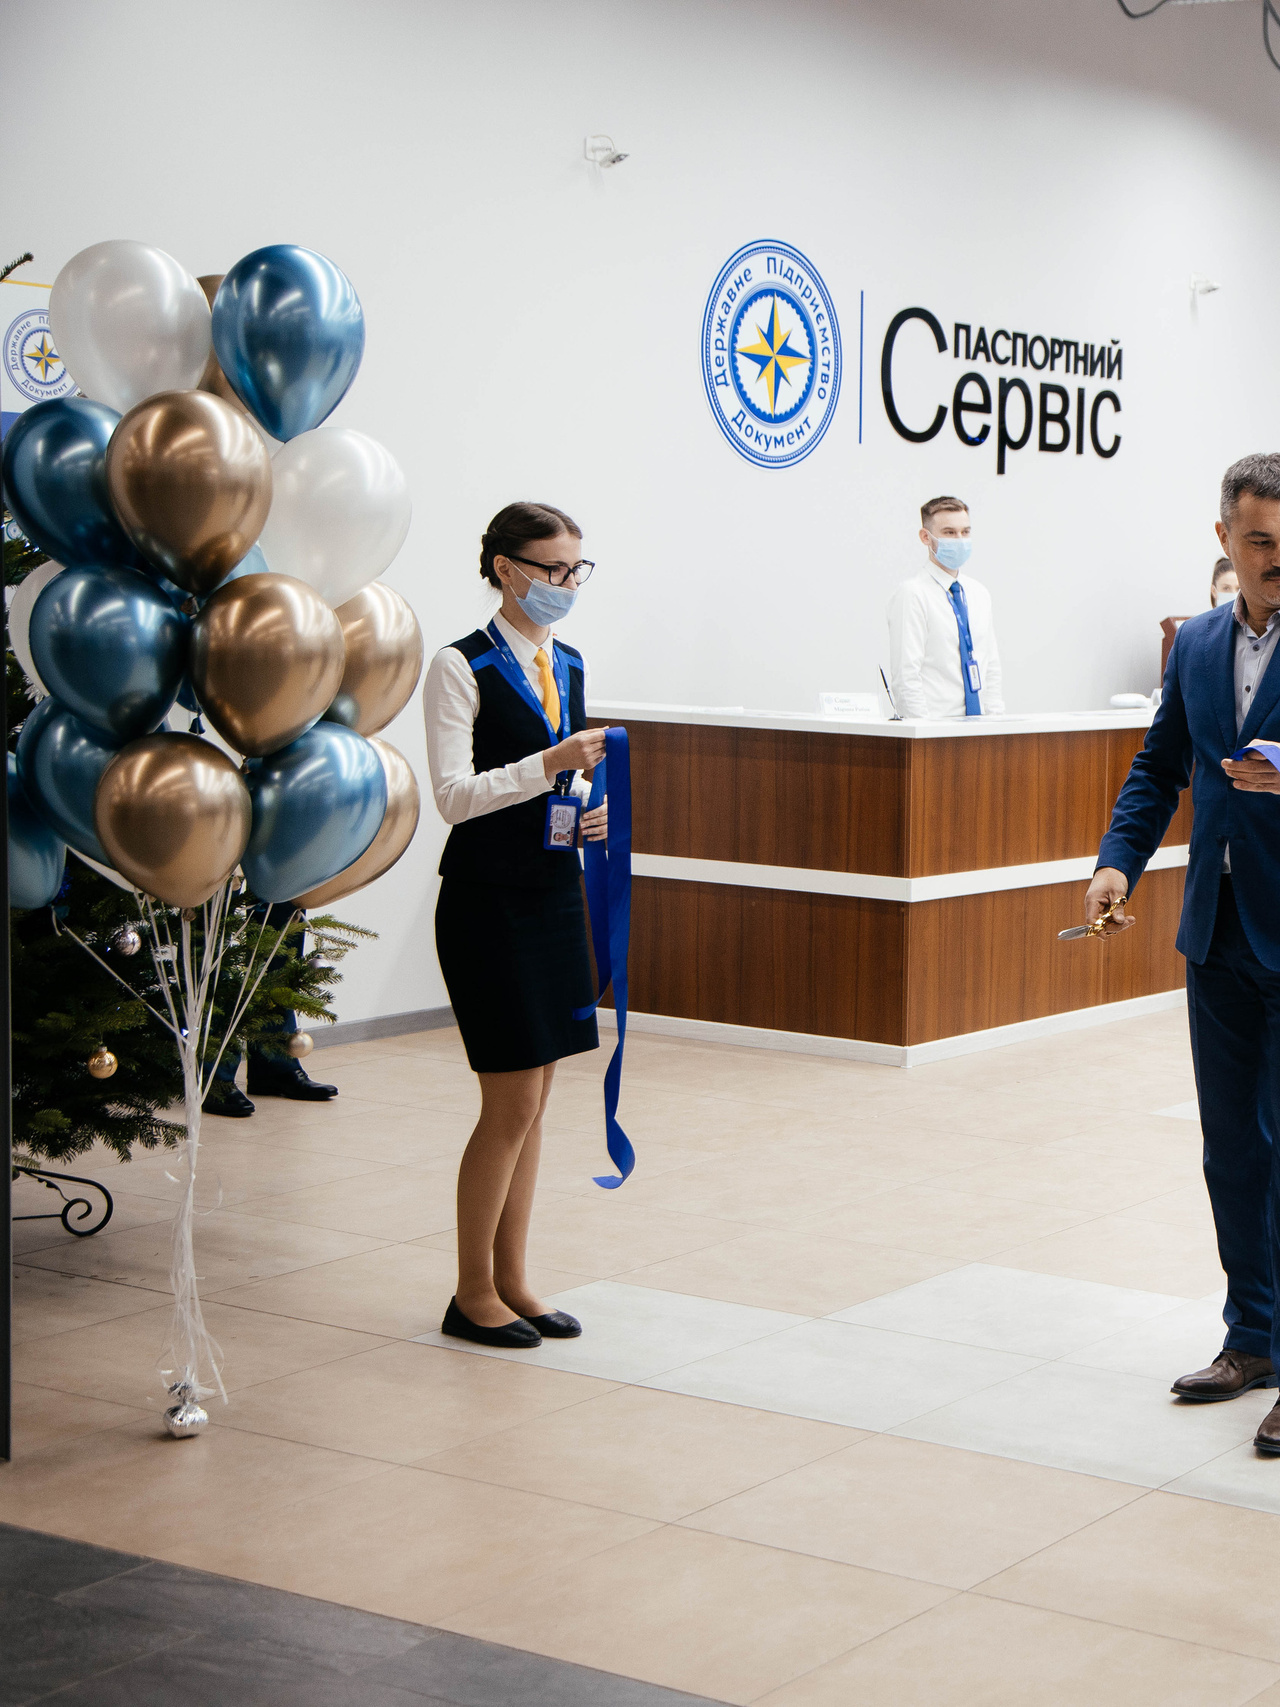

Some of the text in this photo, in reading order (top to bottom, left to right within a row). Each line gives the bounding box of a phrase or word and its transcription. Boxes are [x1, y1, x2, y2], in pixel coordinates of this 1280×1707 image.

[11, 320, 32, 371] Державне
[713, 255, 831, 400] Державне Підприємство
[953, 322, 1123, 381] ПАСПОРТНИЙ
[21, 378, 68, 398] Документ
[880, 307, 1123, 475] Сервіс
[731, 408, 813, 451] Документ
